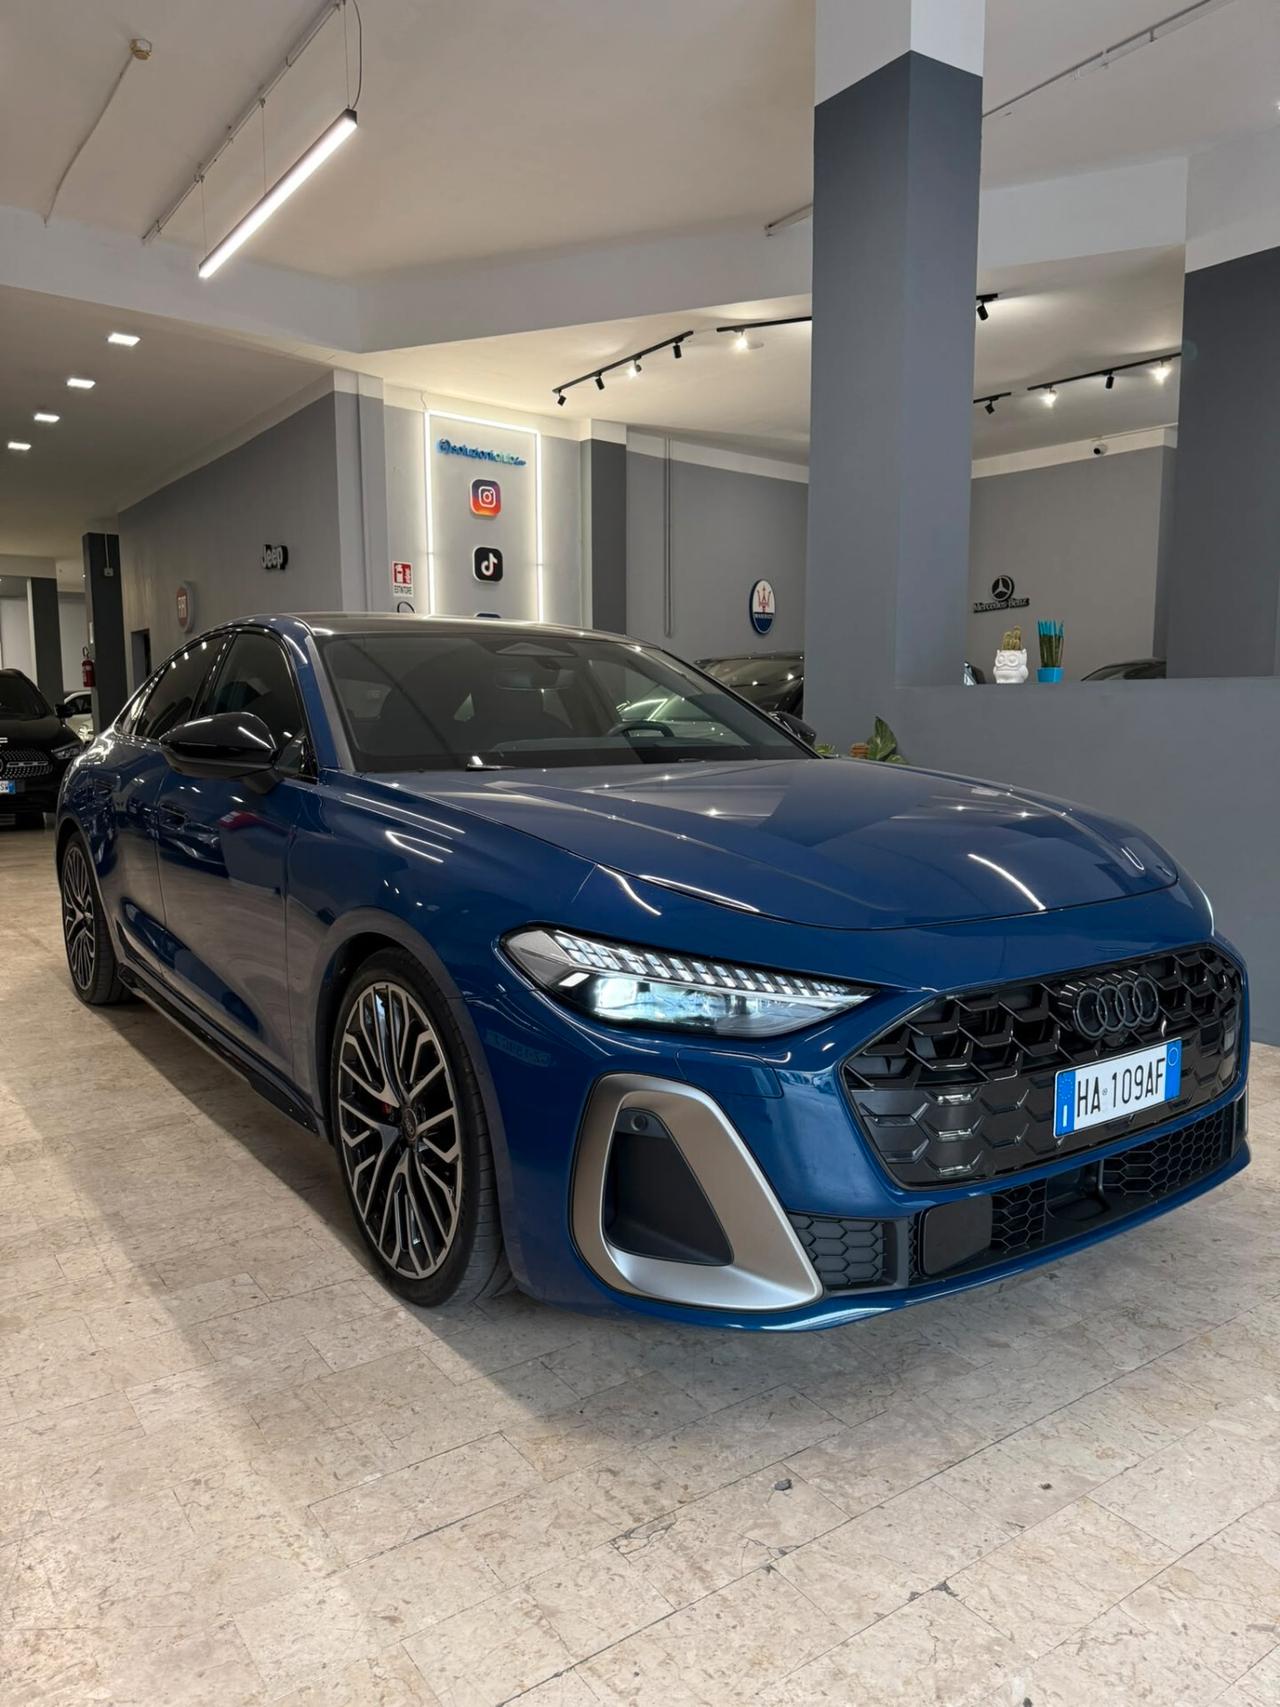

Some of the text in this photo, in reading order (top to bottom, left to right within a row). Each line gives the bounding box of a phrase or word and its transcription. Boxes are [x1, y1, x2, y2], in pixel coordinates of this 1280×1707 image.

[262, 544, 285, 569] Jeep
[1077, 1076, 1101, 1118] HA
[1111, 1057, 1166, 1109] 109AF
